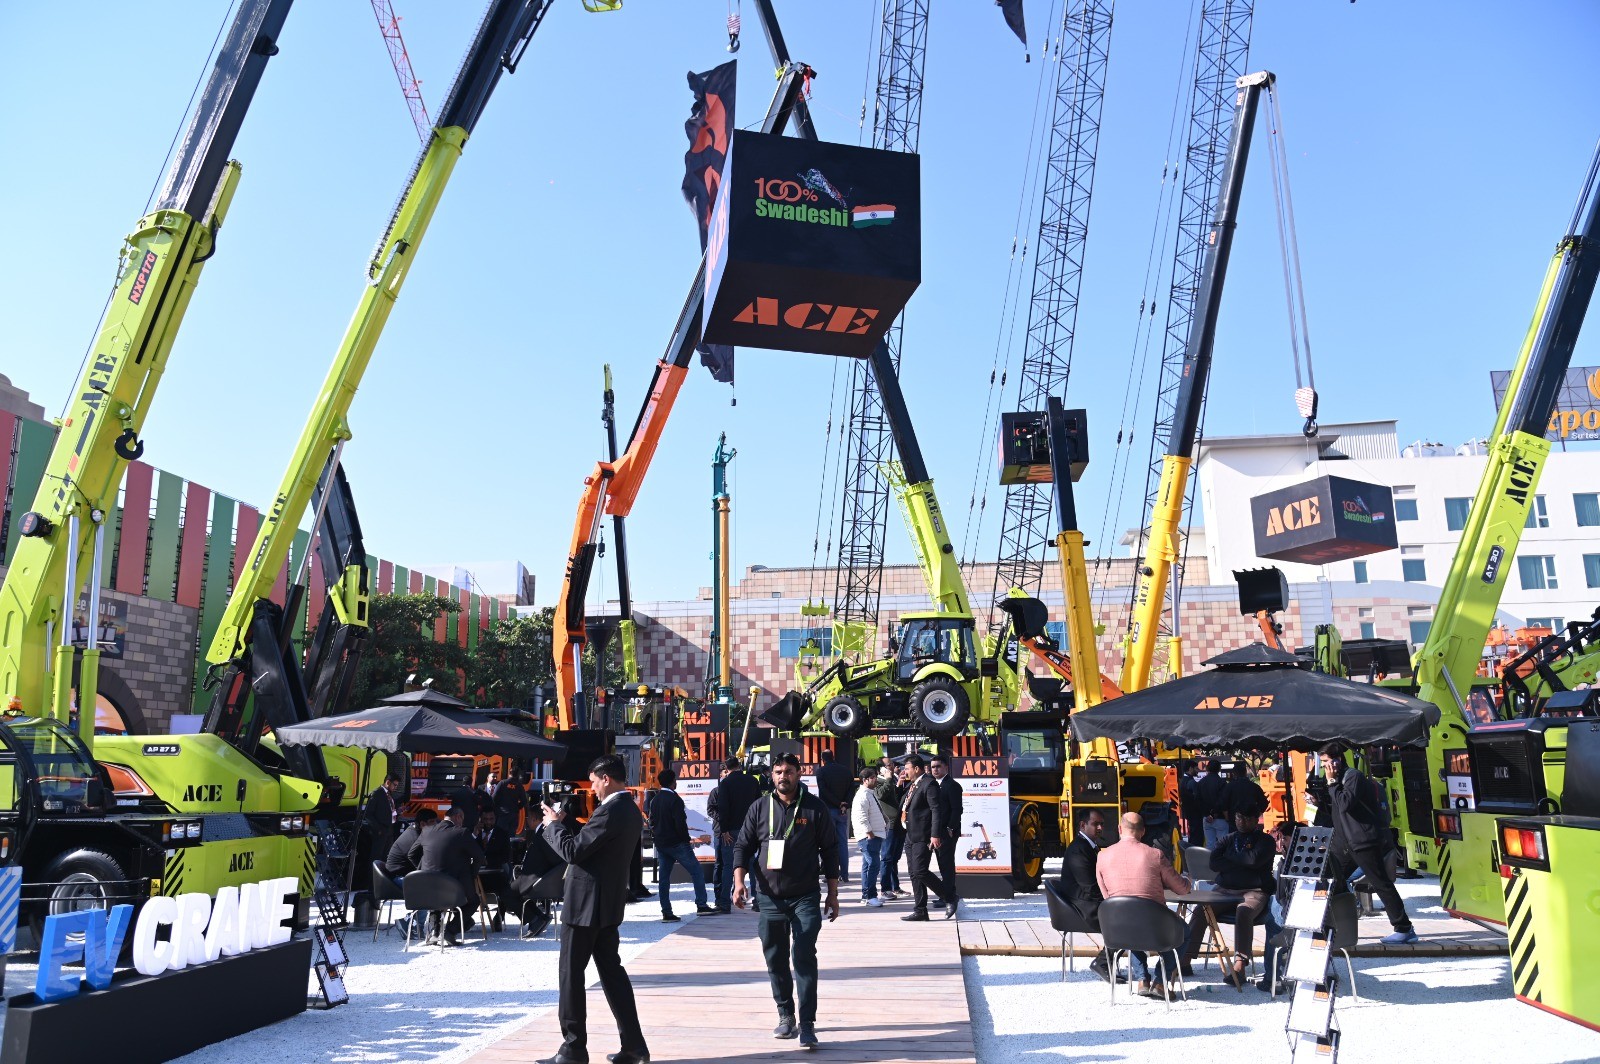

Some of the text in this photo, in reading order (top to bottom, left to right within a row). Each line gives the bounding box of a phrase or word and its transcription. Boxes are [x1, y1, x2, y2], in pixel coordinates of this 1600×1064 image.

[755, 178, 818, 202] 100%
[756, 199, 848, 227] Swadeshi
[130, 252, 156, 303] NXP170
[732, 297, 879, 335] ACE
[81, 354, 117, 410] ACE
[1548, 409, 1600, 438] xpo
[1505, 456, 1537, 506] ACE
[924, 492, 939, 515] ACE
[1266, 496, 1320, 536] ACE
[1344, 511, 1372, 524] Swadeshi
[1485, 549, 1500, 579] AT 30
[107, 602, 117, 617] in
[629, 697, 646, 706] ACE
[1194, 694, 1275, 710] ACE
[679, 763, 710, 778] ACE
[962, 760, 999, 776] ACE
[1494, 766, 1509, 778] ACE
[182, 785, 222, 802] ACE
[1087, 782, 1102, 790] ACE
[1415, 839, 1429, 856] ACE
[229, 851, 254, 872] ACE
[35, 877, 299, 1000] EV CRANE
